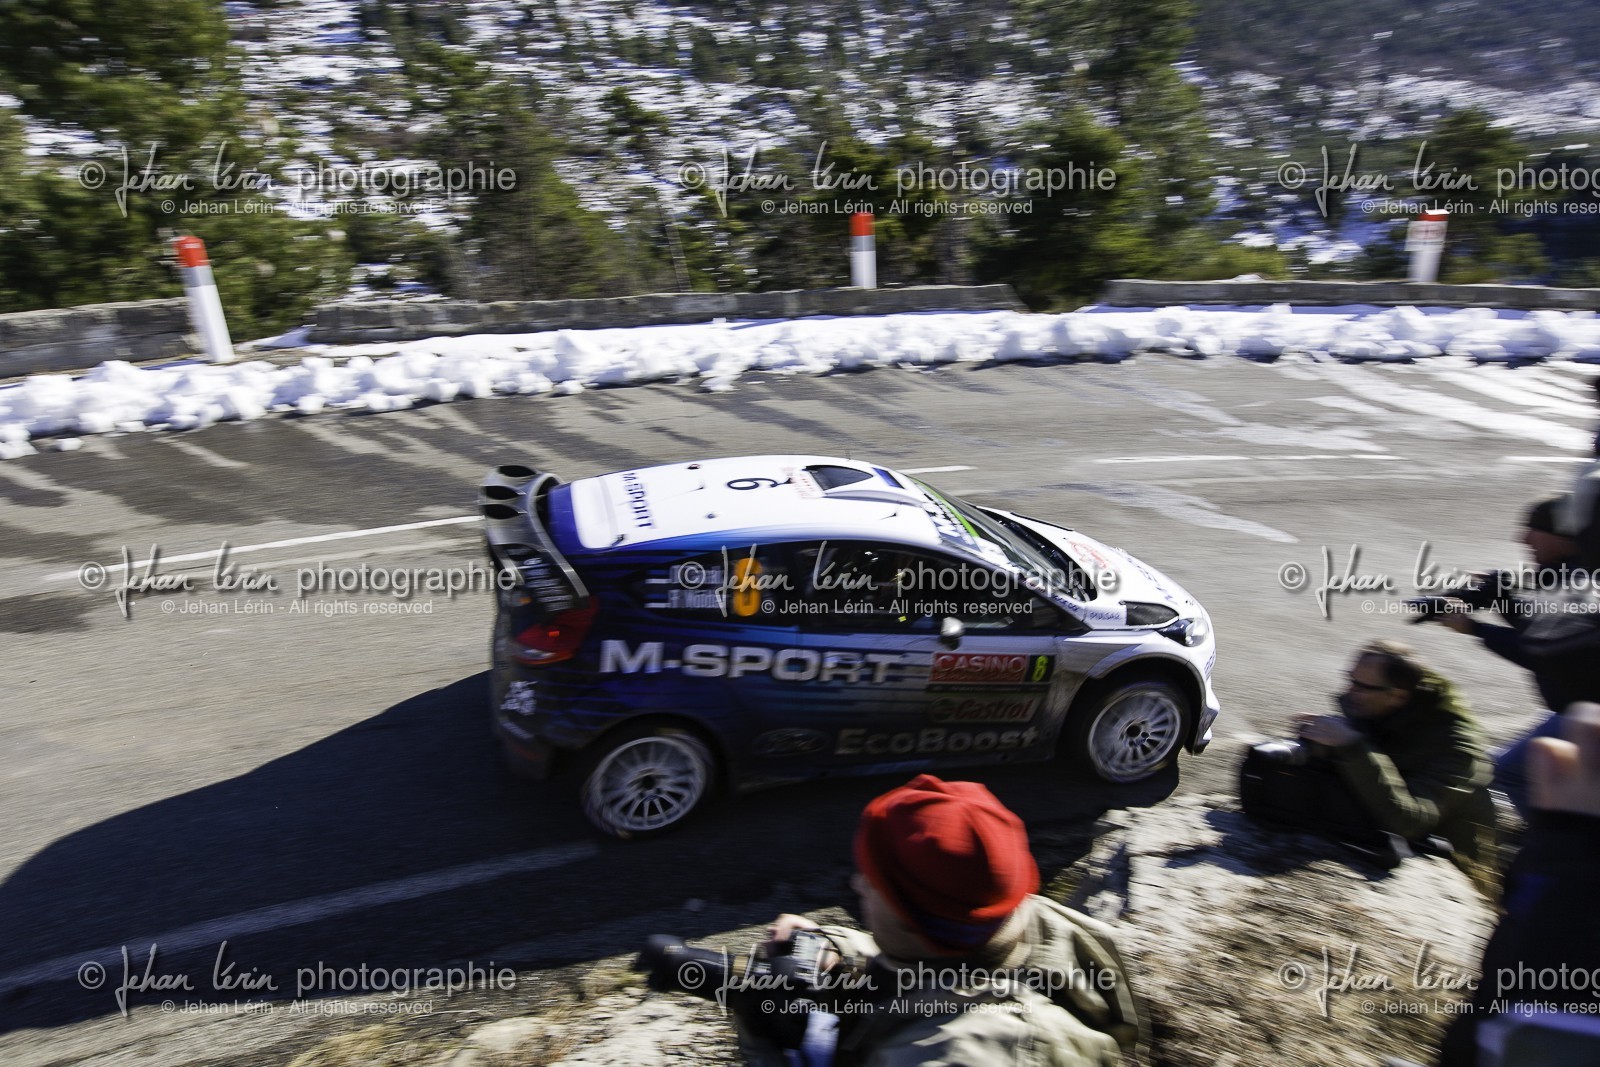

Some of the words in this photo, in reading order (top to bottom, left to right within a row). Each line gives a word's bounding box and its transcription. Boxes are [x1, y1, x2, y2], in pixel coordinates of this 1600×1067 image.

[600, 639, 904, 684] M-SPORT
[934, 655, 1025, 673] CASINO
[955, 699, 1035, 720] Castrol
[833, 726, 1040, 756] EcoBoost
